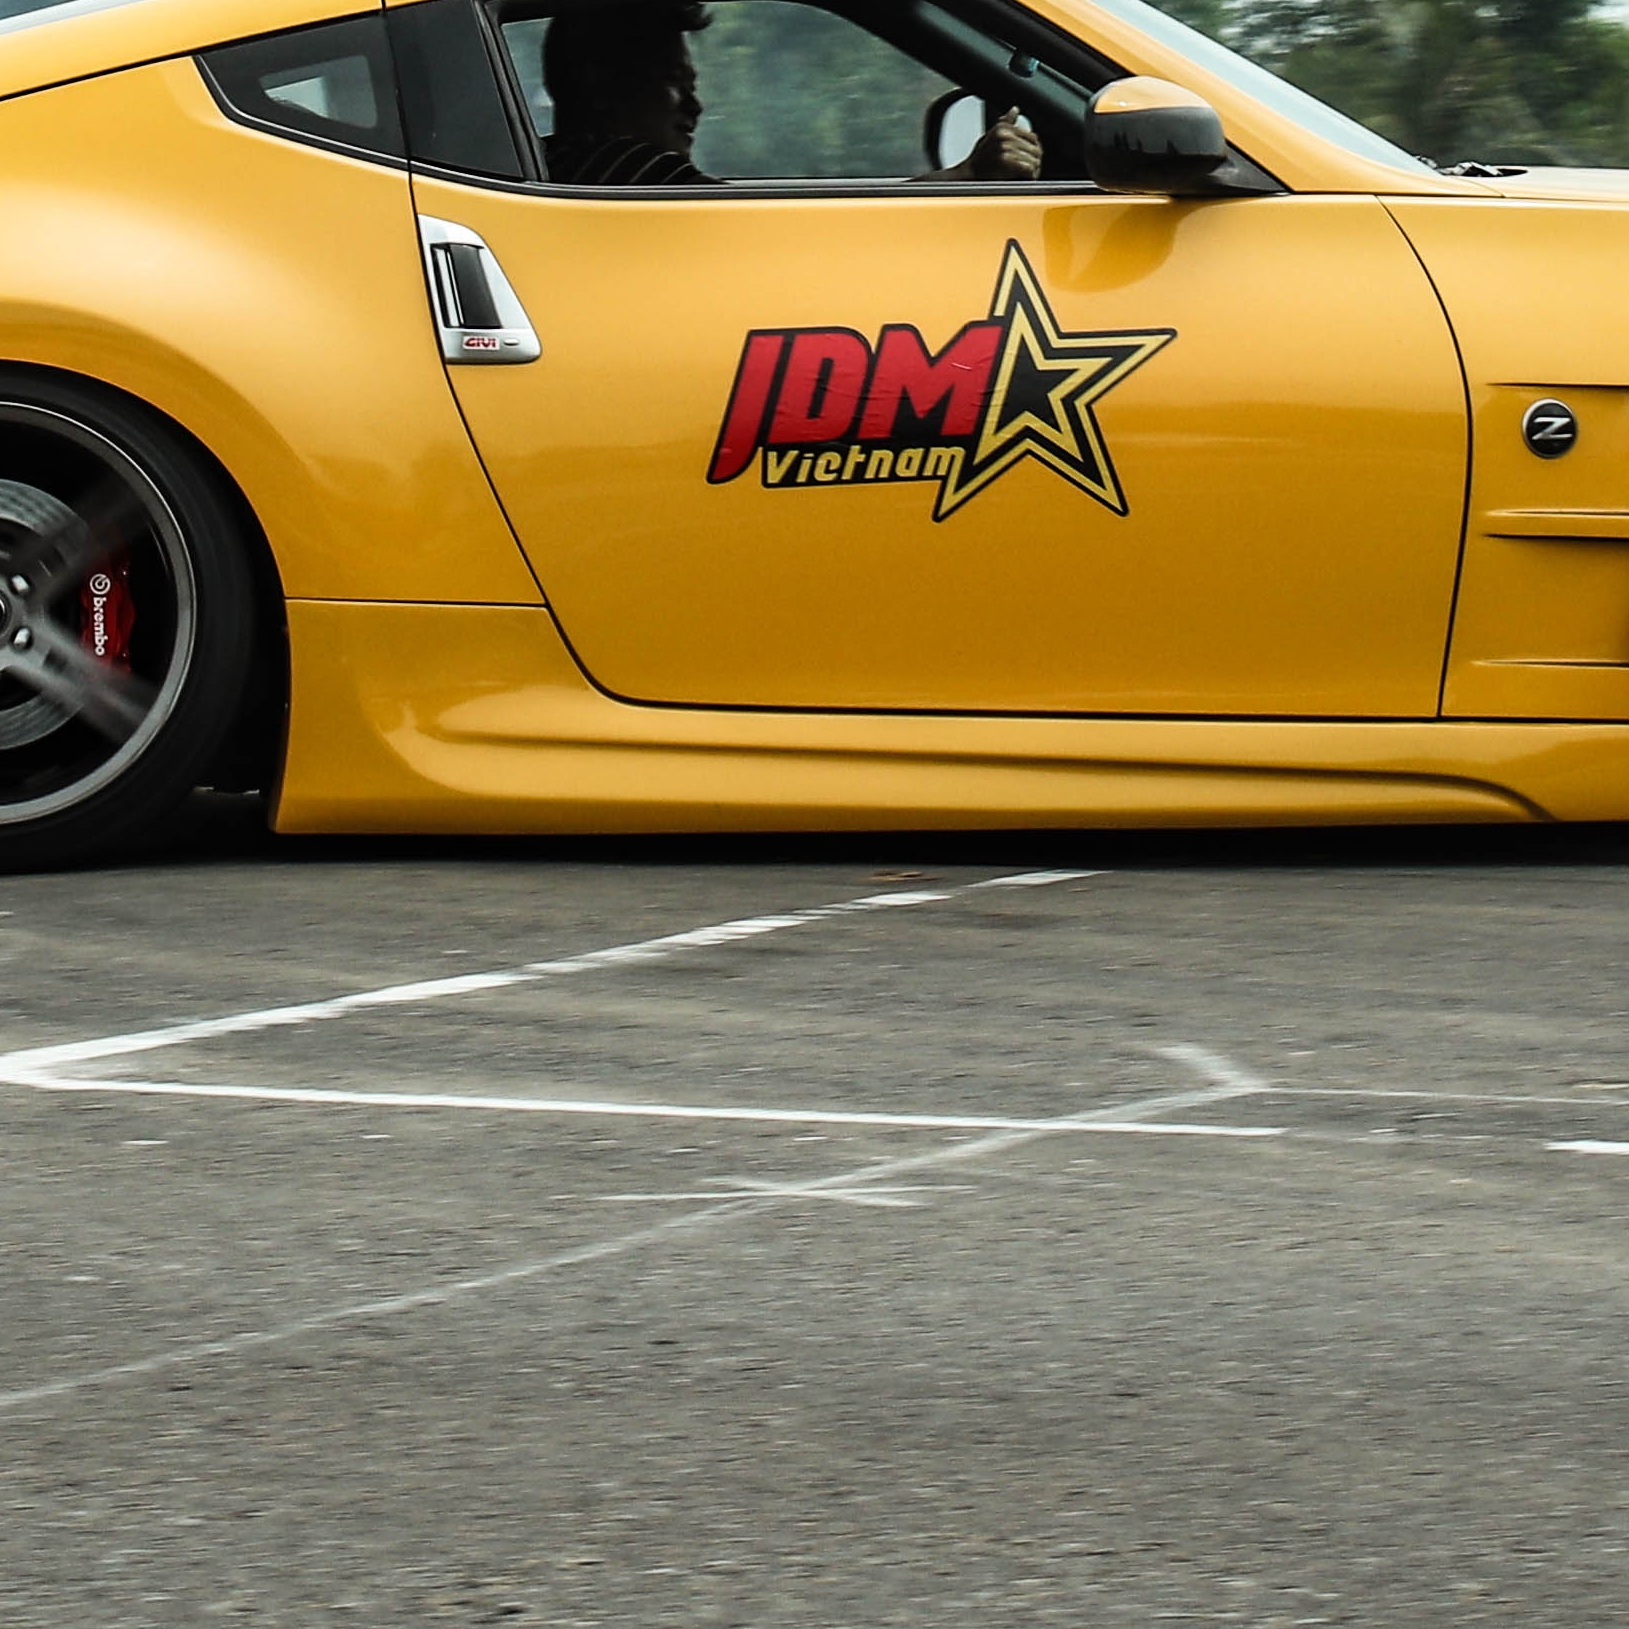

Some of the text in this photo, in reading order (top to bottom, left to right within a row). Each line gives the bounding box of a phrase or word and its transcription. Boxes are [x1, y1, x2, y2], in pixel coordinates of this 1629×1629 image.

[708, 325, 1004, 479] JDM
[1532, 417, 1573, 440] Z
[766, 445, 966, 484] Vietnam
[93, 597, 109, 656] brembo
